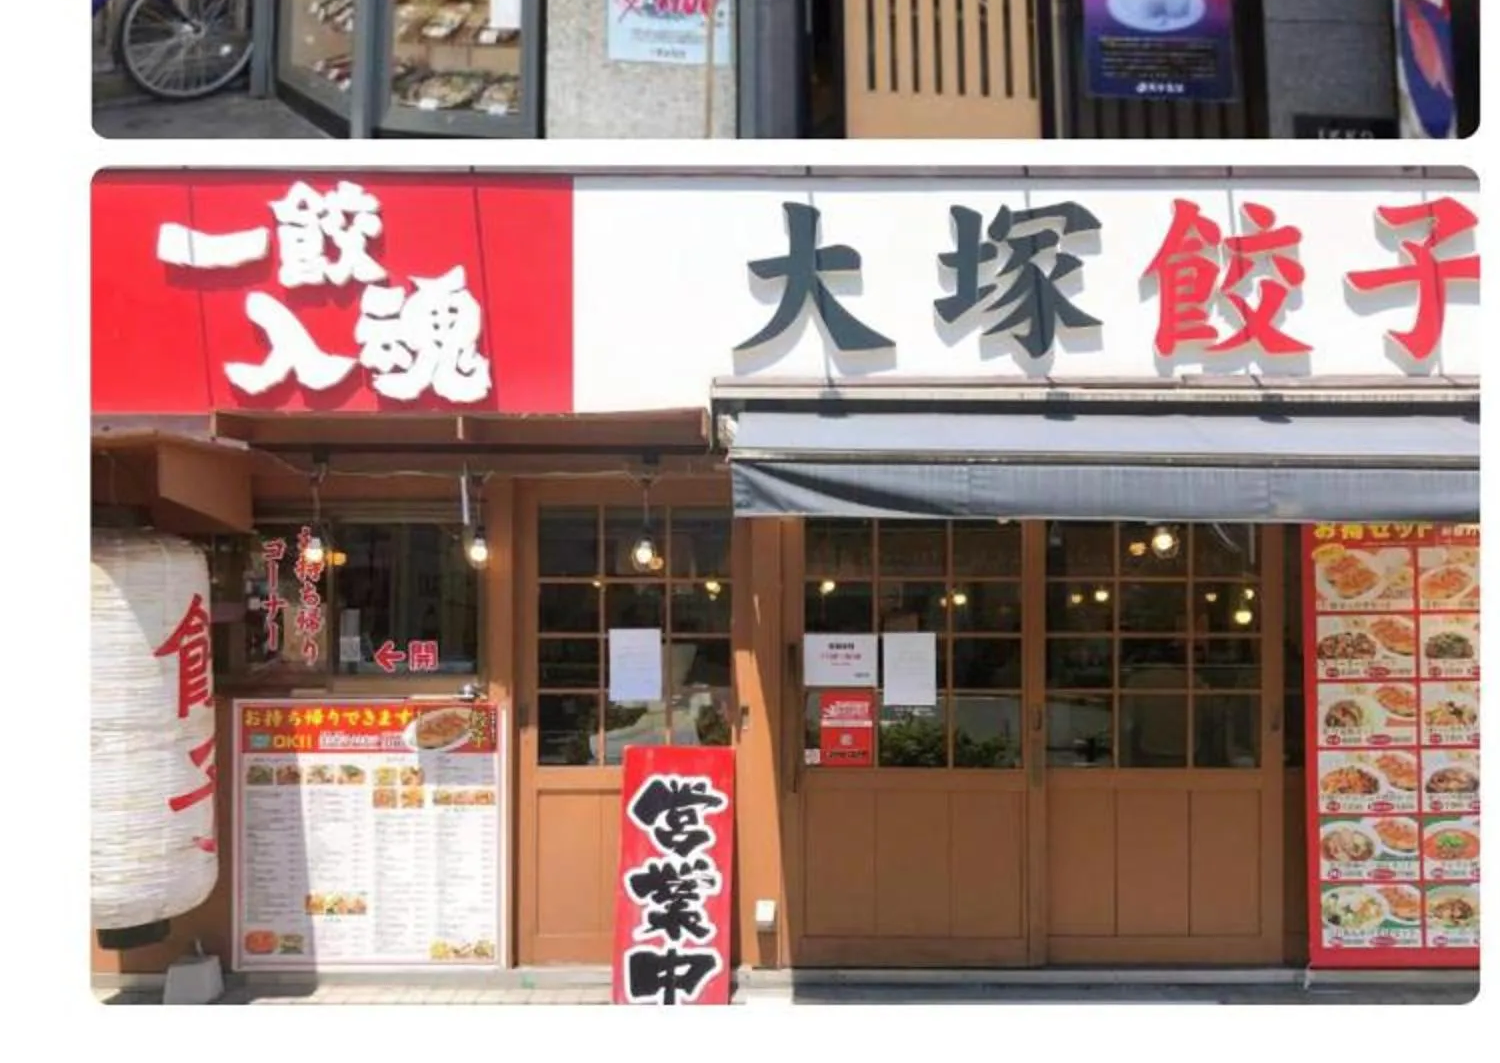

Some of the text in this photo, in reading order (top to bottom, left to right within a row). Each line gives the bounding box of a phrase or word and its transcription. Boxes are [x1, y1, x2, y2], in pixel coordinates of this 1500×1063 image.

[157, 180, 388, 287] 一餃
[732, 197, 1480, 360] 大塚餃子
[223, 265, 491, 401] 入魂
[262, 538, 288, 652] コーナー
[409, 641, 439, 671] 開
[630, 777, 727, 1004] 営業中
